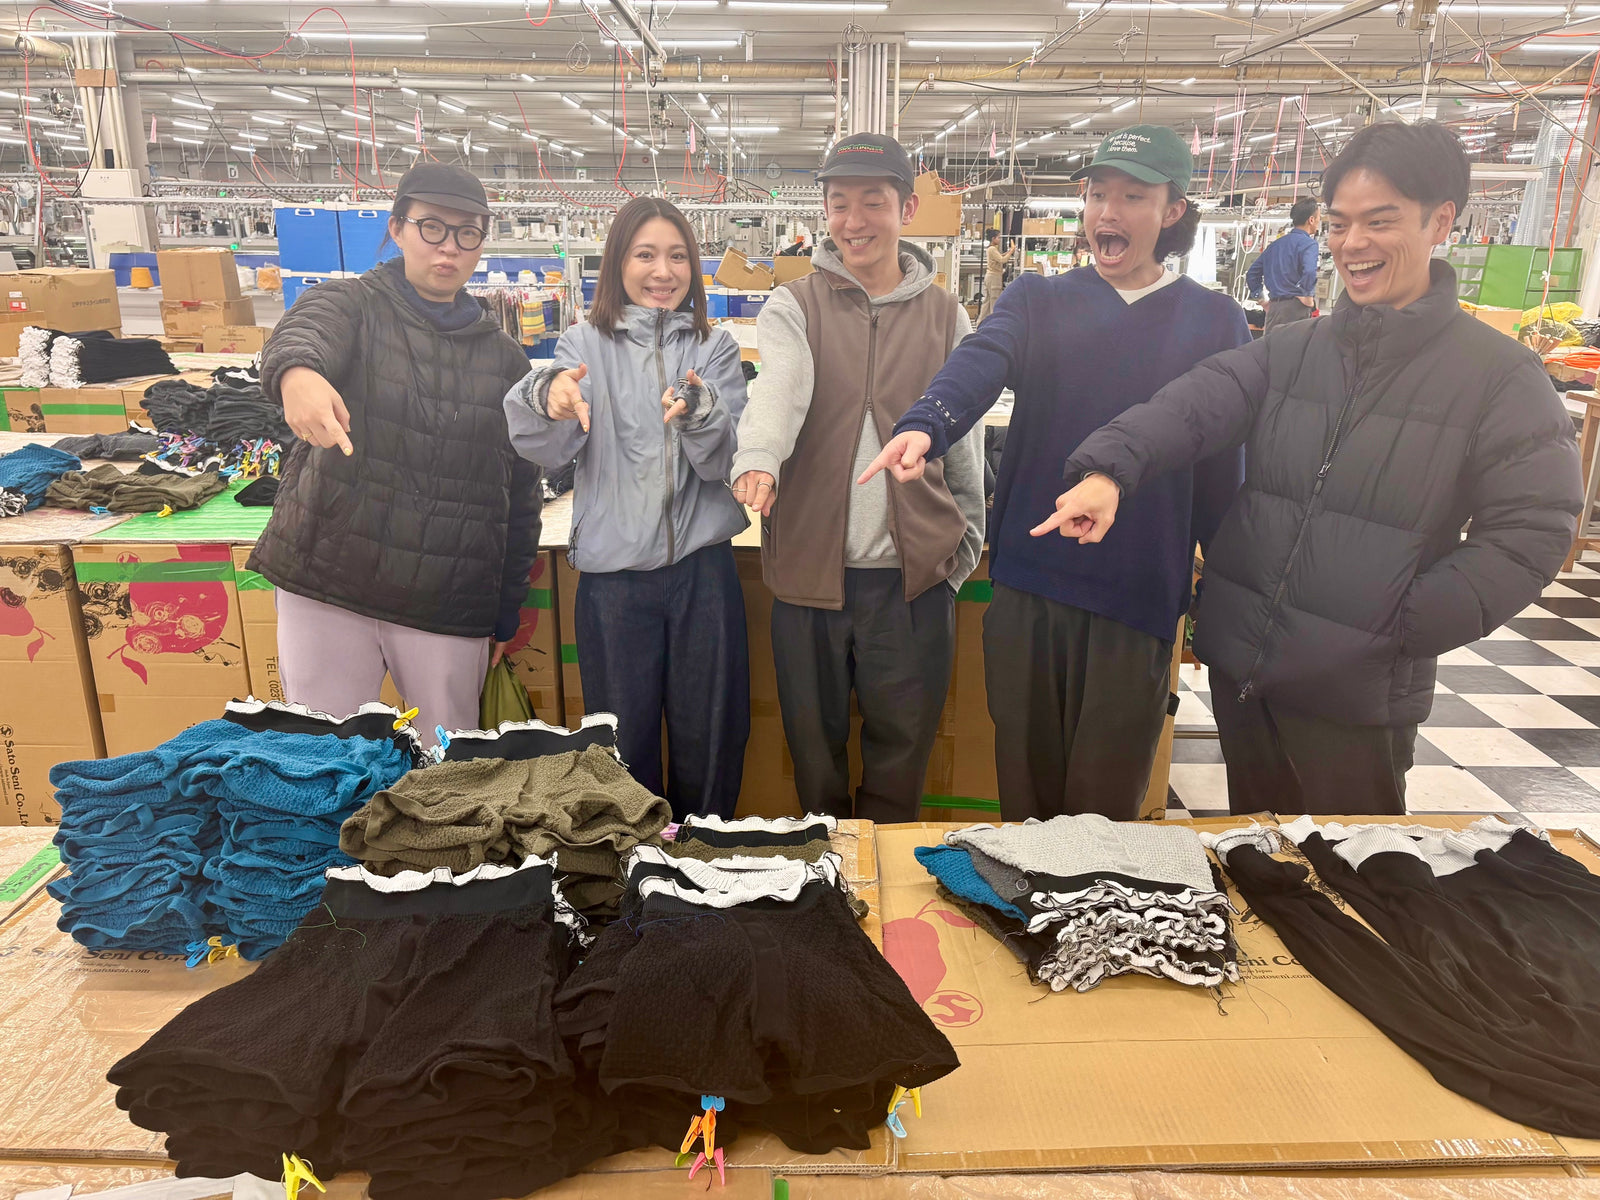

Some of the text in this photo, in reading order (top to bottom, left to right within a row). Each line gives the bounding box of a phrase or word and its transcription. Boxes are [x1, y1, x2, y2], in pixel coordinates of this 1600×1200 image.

[229, 167, 237, 178] D
[265, 655, 277, 676] TEL
[5, 739, 15, 765] Sato
[10, 766, 23, 790] Seni
[1236, 957, 1268, 967] eni
